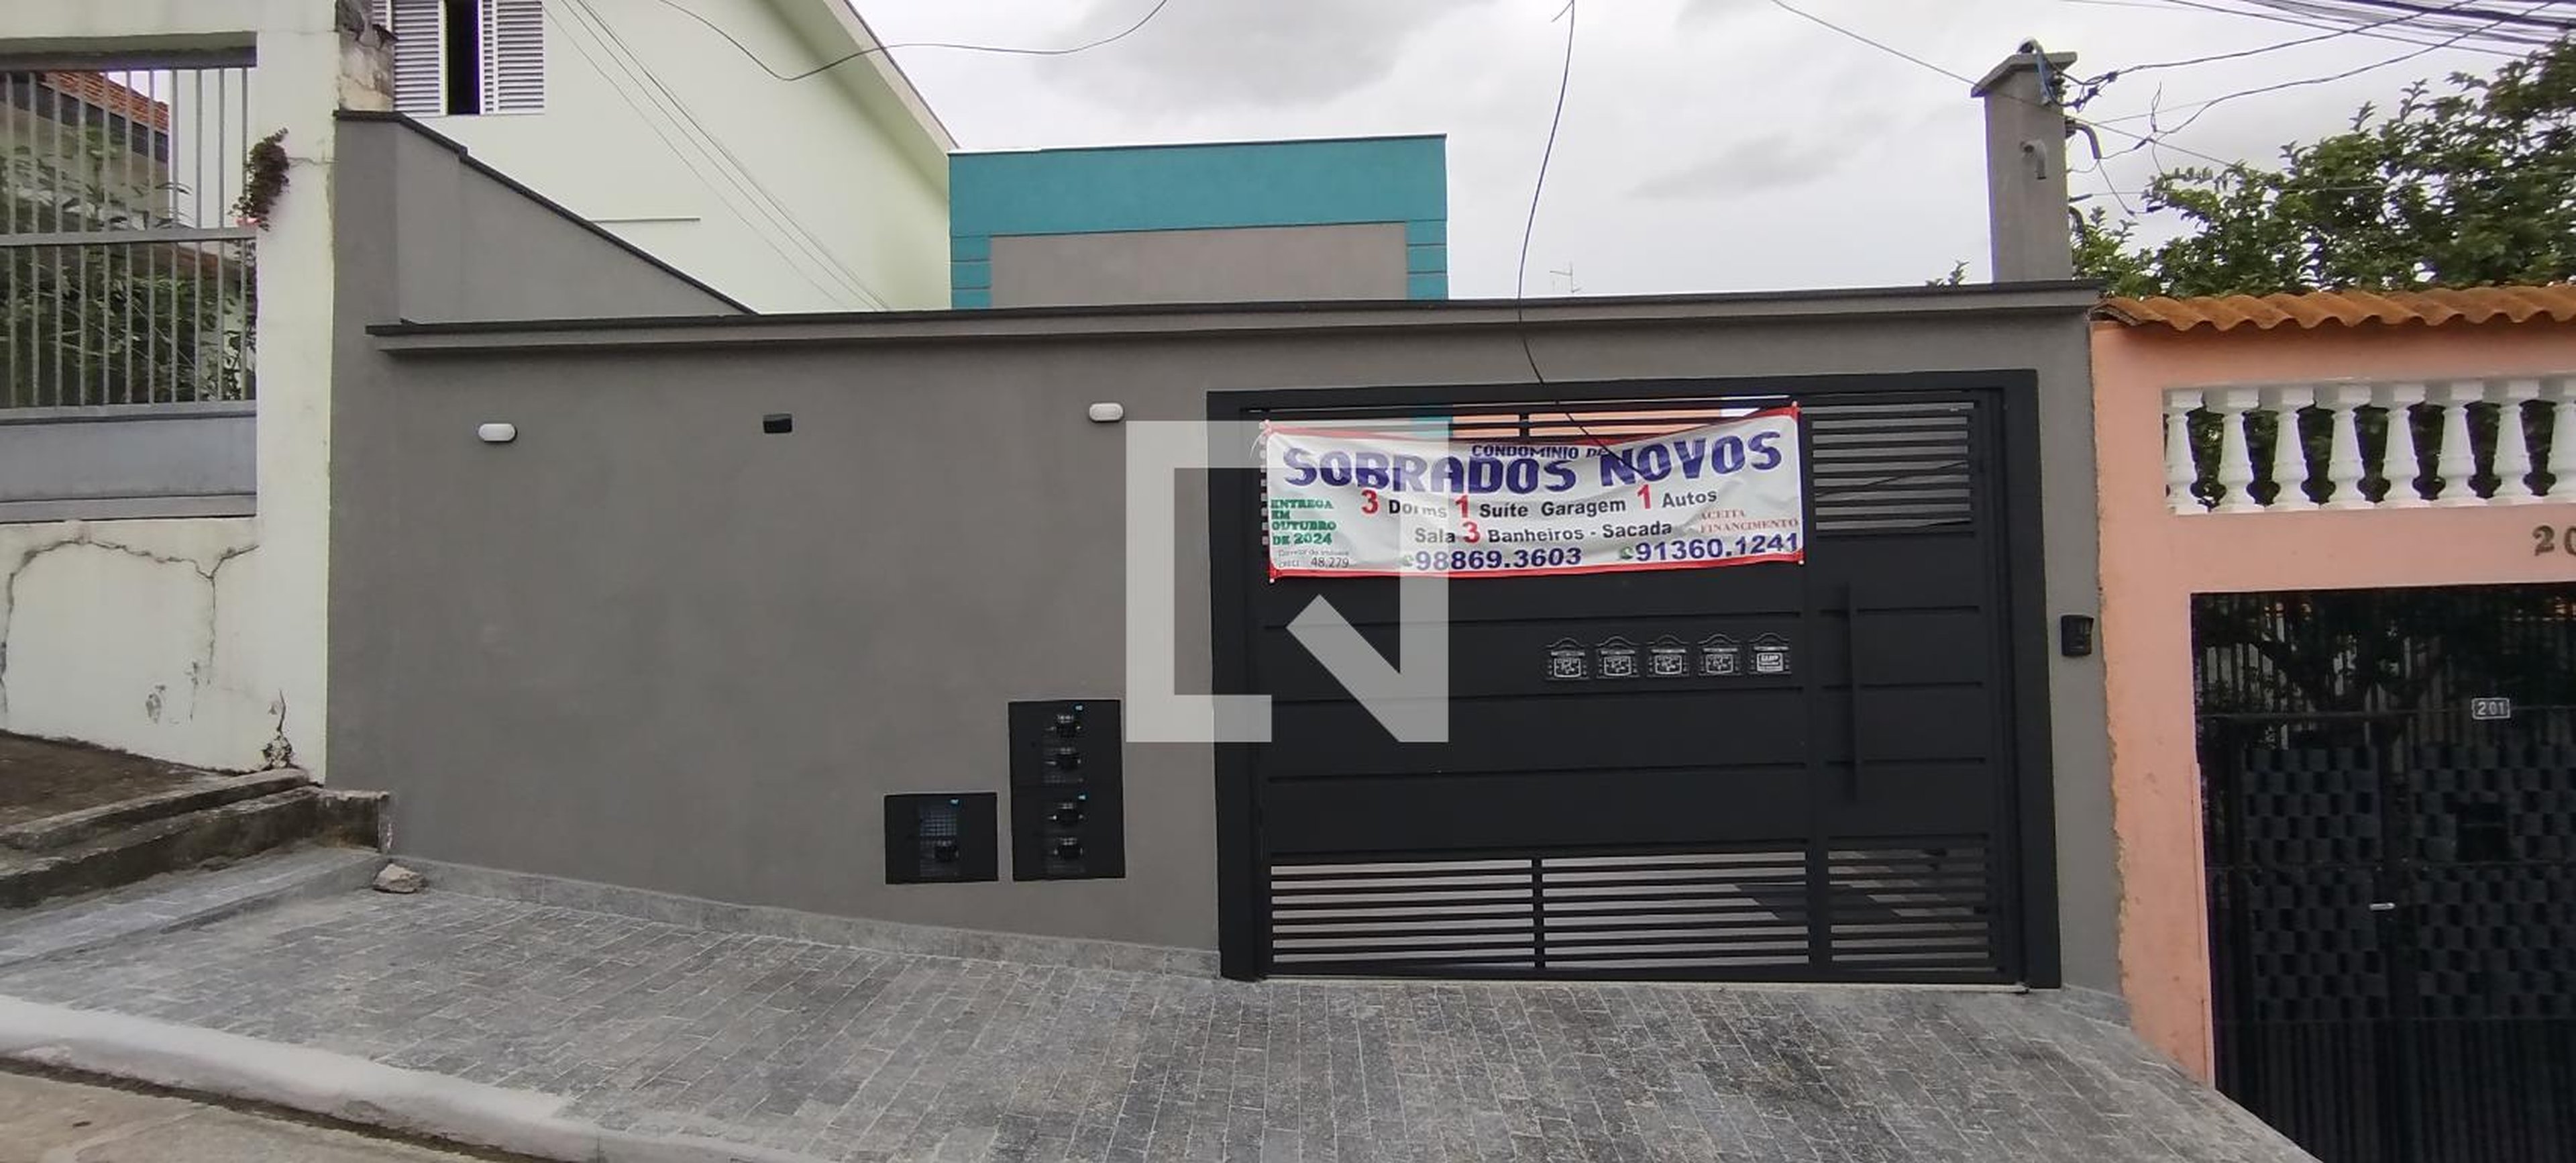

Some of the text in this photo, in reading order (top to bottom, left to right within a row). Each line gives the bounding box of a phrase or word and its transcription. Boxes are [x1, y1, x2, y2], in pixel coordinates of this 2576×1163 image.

[1472, 444, 1578, 459] CONDOMINIO
[1283, 431, 1782, 494] SOBRADOS NOVOS
[1271, 499, 1334, 509] ENTREGA
[1360, 490, 1379, 514] 3
[1388, 499, 1448, 518] Dorms
[1454, 495, 1469, 519] 1
[1540, 499, 1626, 517] Garagem
[1637, 484, 1651, 509] 1
[1662, 489, 1717, 509] Autos
[1271, 510, 1291, 519] EM
[1701, 509, 1746, 520] ACEITA
[1272, 521, 1337, 530] OUTUBRO
[1414, 527, 1456, 543] Sala
[1462, 521, 1481, 544] 3
[1487, 527, 1584, 543] Banheiros
[1602, 521, 1672, 539] Sacada
[1700, 518, 1799, 534] FINANCIMENTO
[1273, 533, 1332, 545] DE 2024
[1635, 533, 1798, 562] 91360.1241
[1416, 547, 1582, 570] 98869.3603
[2477, 701, 2506, 715] 201
